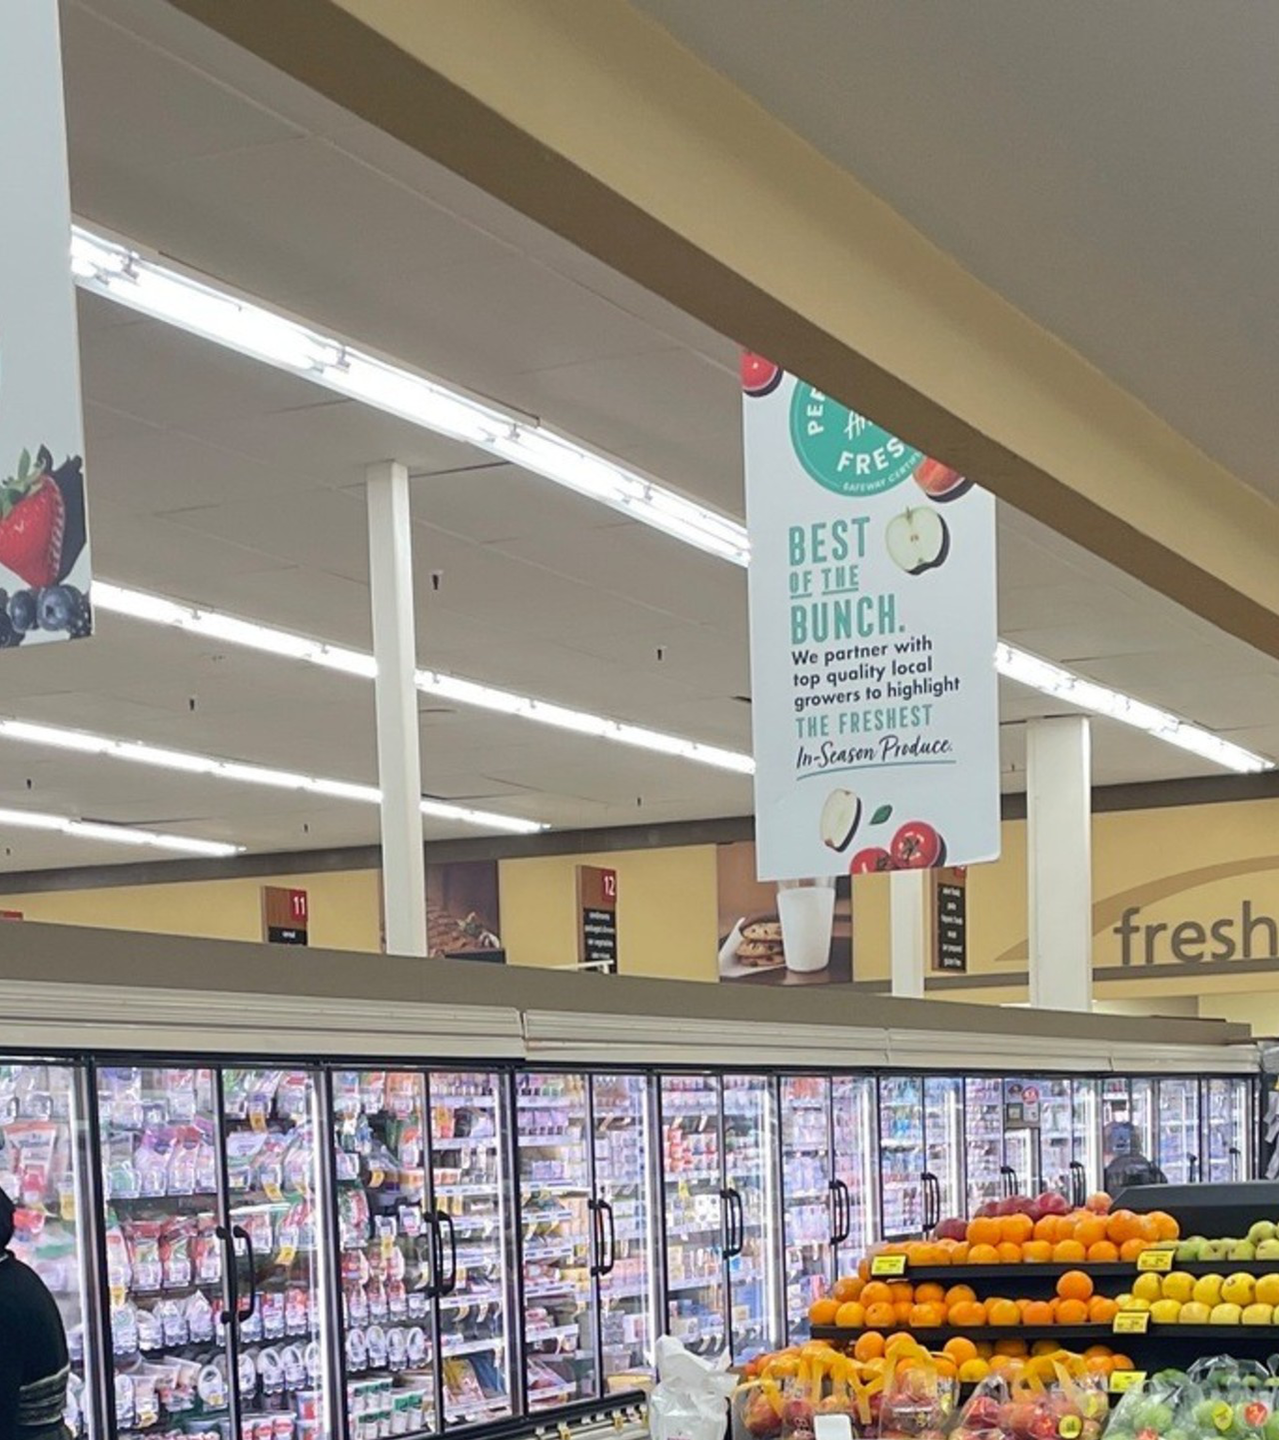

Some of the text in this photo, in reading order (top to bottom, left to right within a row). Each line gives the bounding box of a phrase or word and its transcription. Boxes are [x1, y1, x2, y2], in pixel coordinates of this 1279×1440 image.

[837, 437, 906, 475] FRES
[789, 517, 870, 567] BEST
[790, 565, 859, 594] OF THE
[791, 593, 906, 645] BUNCH.
[792, 635, 933, 667] We partner with
[793, 656, 933, 690] top quality local
[794, 677, 960, 712] growers to highlight
[796, 704, 933, 738] THE FRESHEST
[796, 735, 953, 769] In-Season Produce.
[604, 875, 615, 896] 12
[293, 896, 305, 915] 11
[1113, 900, 1278, 966] fresh
